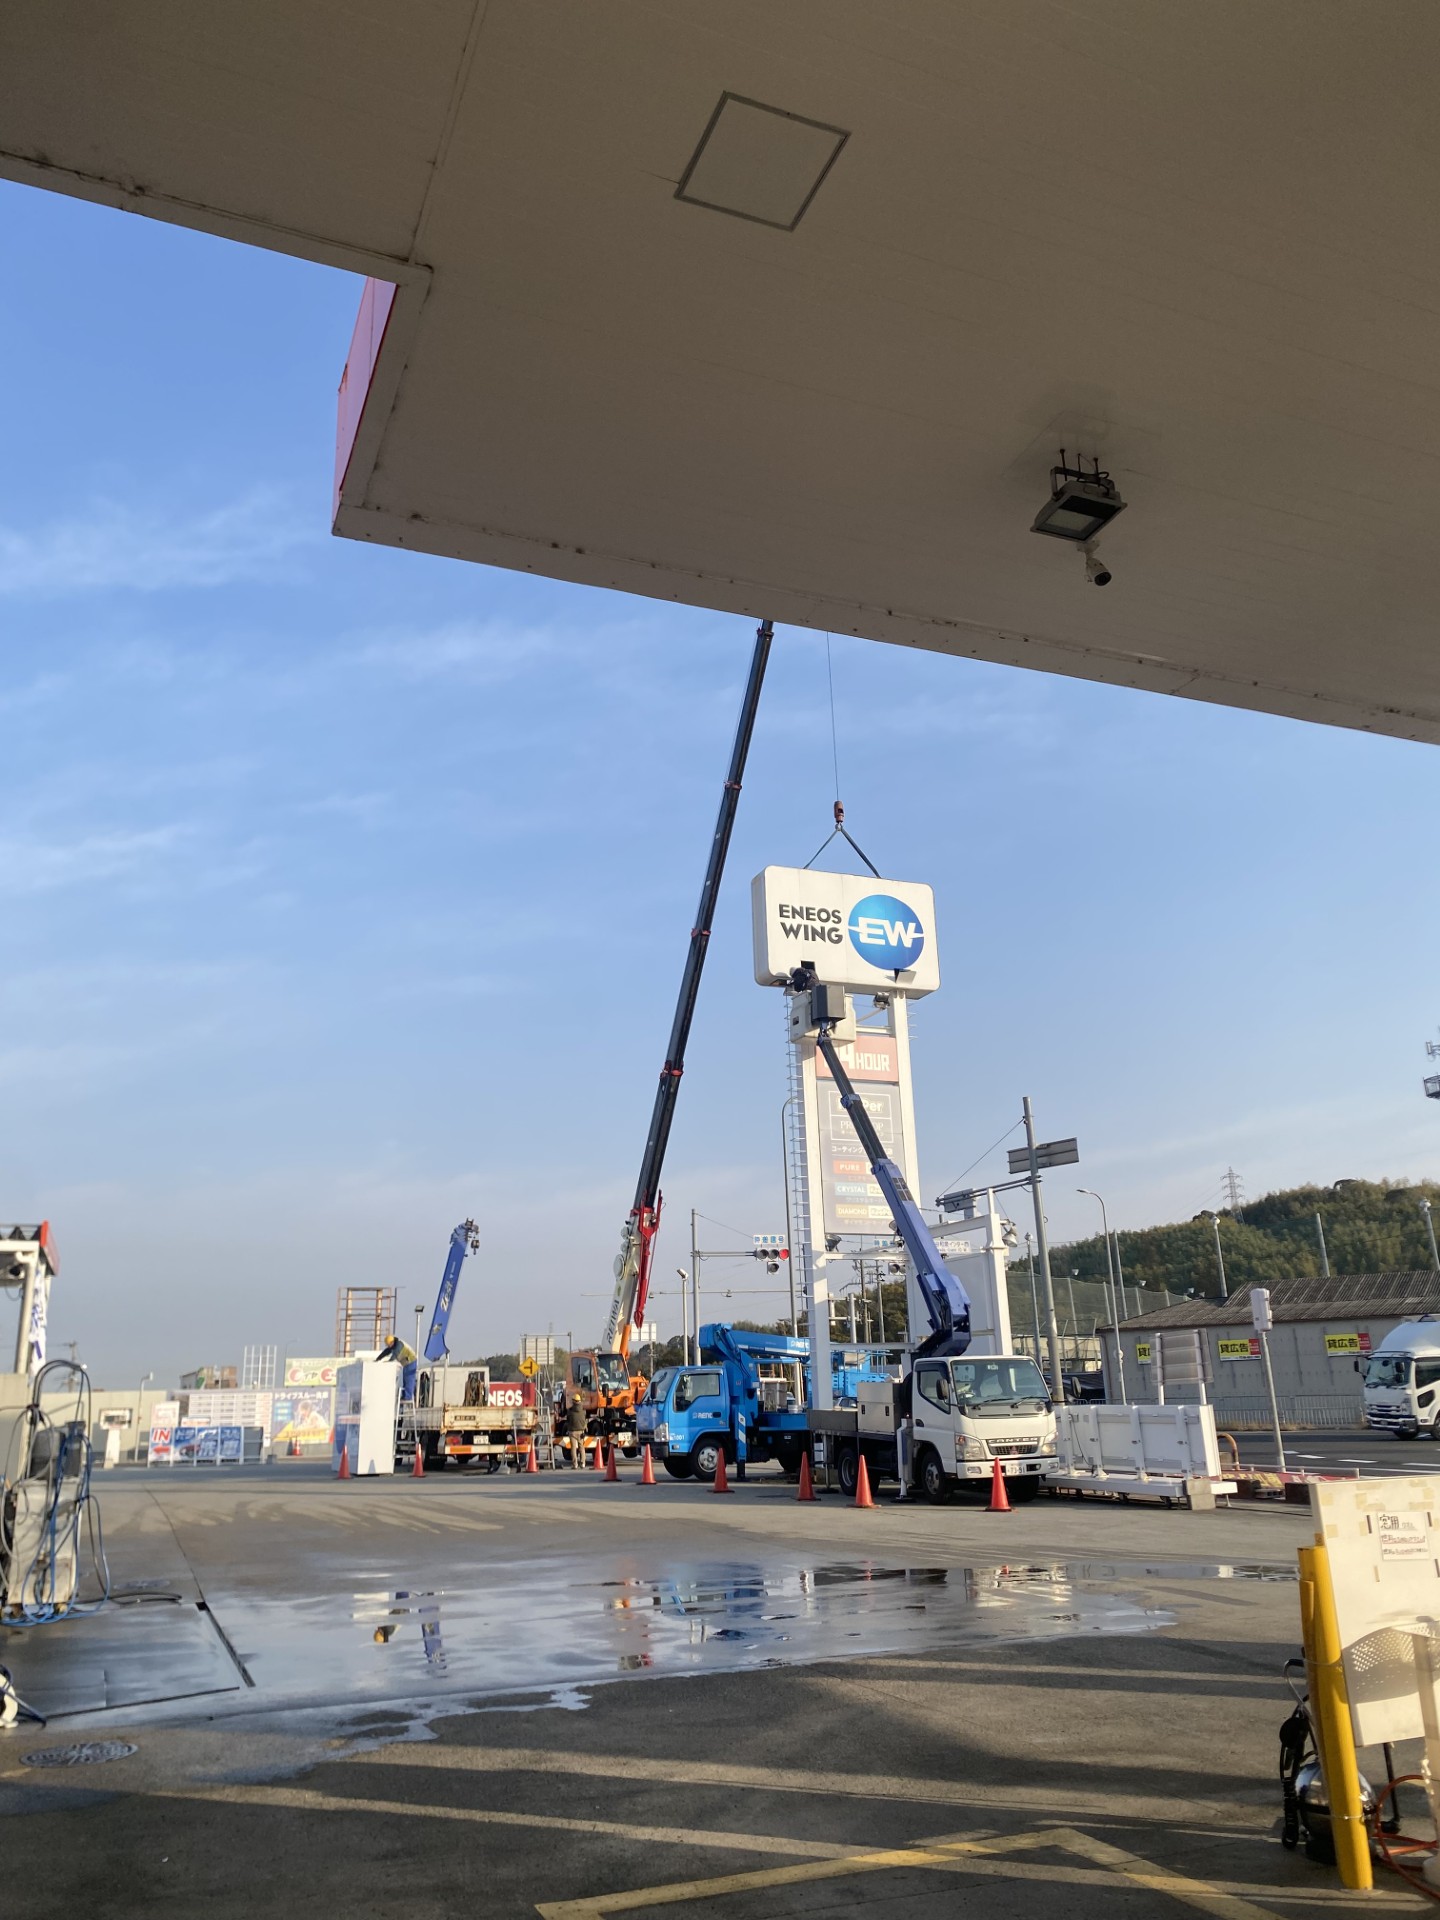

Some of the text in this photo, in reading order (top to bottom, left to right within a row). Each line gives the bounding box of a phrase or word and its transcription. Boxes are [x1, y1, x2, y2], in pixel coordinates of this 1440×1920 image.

[779, 904, 842, 925] ENEOS
[780, 922, 843, 945] WING
[857, 916, 917, 948] EW
[856, 1052, 890, 1072] HOUR
[839, 1163, 860, 1171] PURE
[836, 1185, 866, 1193] CRYSTAL
[838, 1207, 867, 1216] DIAMOND
[1220, 1343, 1249, 1354] 貸広告
[1327, 1338, 1358, 1349] 貸広告
[487, 1389, 523, 1407] NEOS
[152, 1428, 171, 1443] IN
